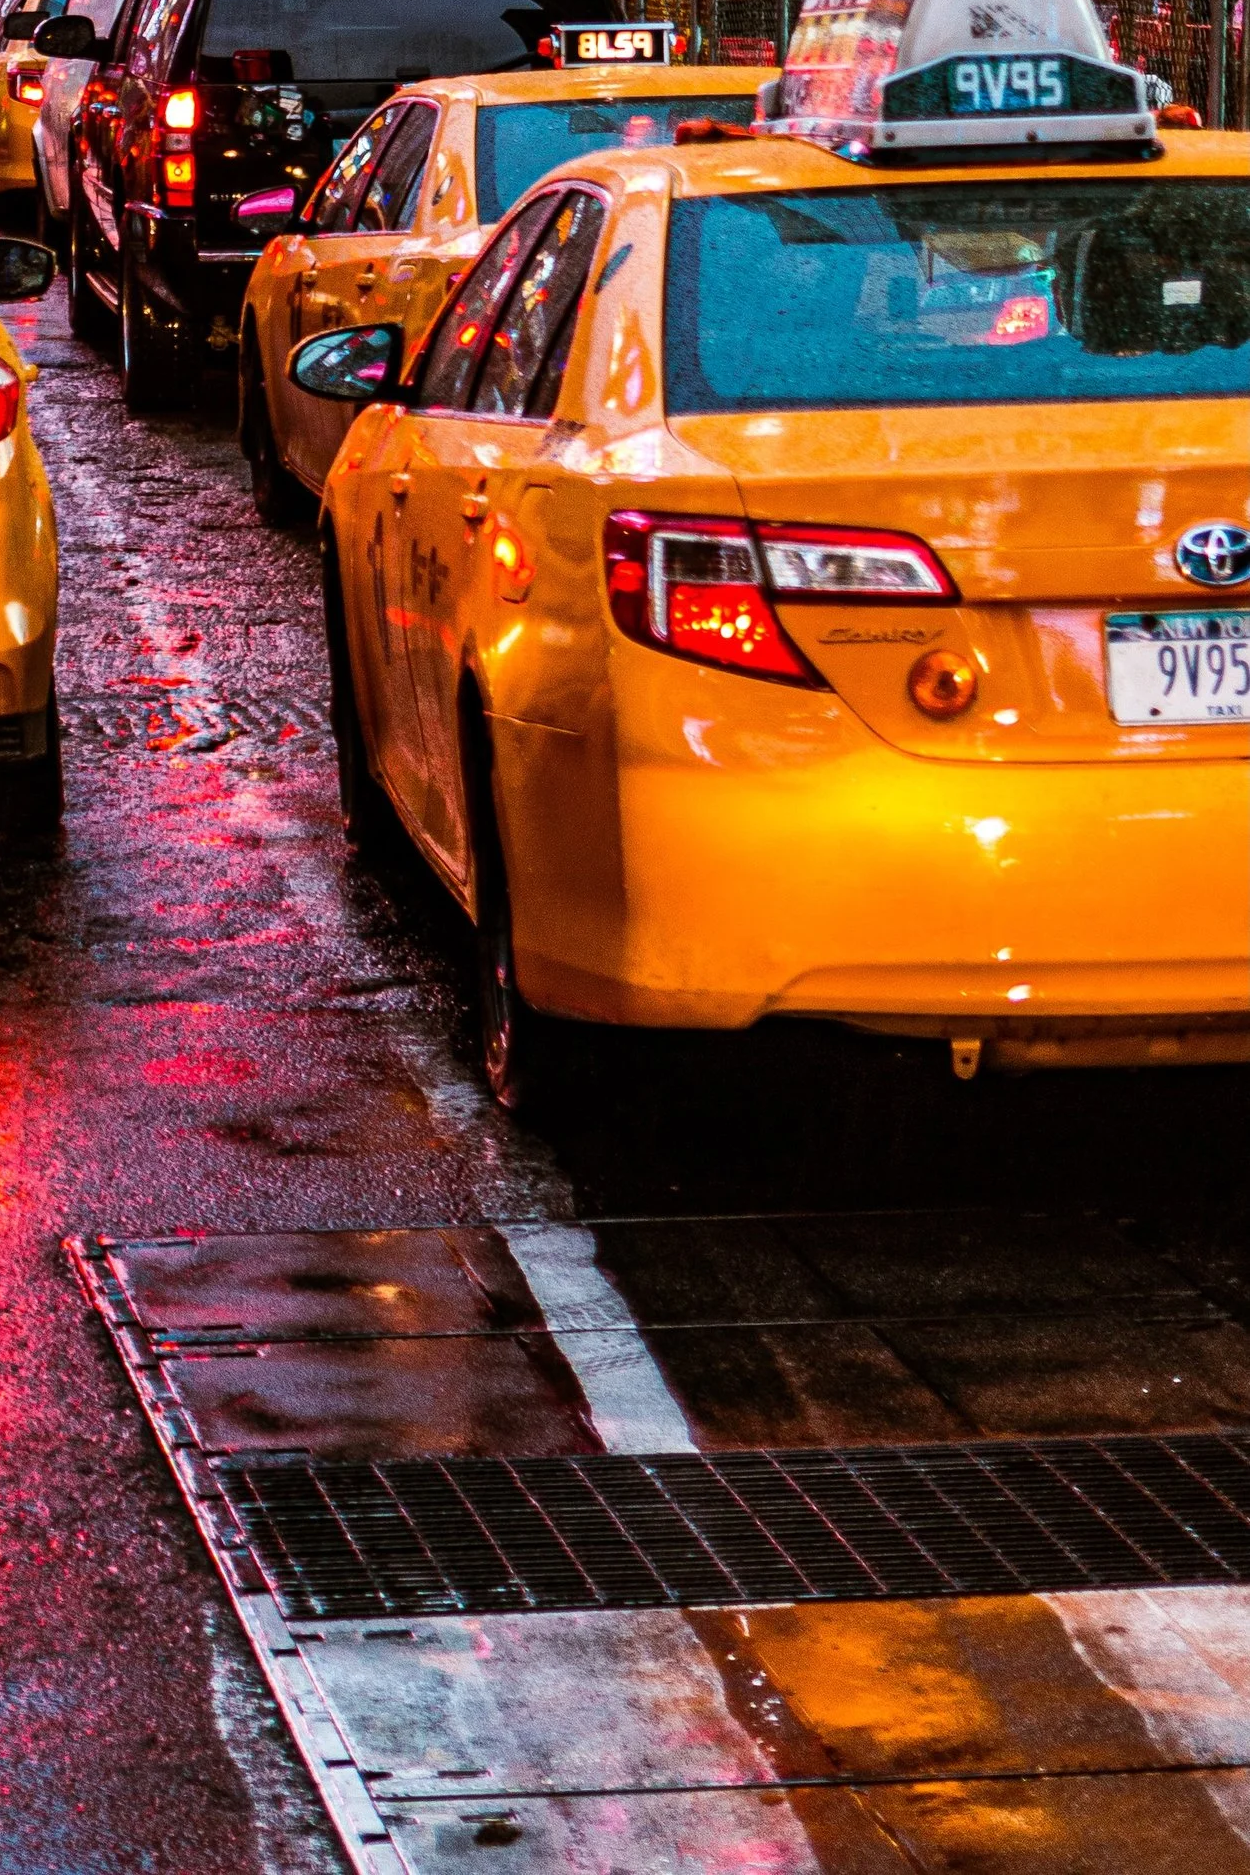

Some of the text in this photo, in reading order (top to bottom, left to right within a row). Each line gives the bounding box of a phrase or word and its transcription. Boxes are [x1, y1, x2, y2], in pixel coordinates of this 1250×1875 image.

[578, 30, 653, 59] 8L59
[956, 61, 1062, 109] 9V95
[1158, 642, 1250, 697] 9V95
[1207, 704, 1243, 717] TAXI
